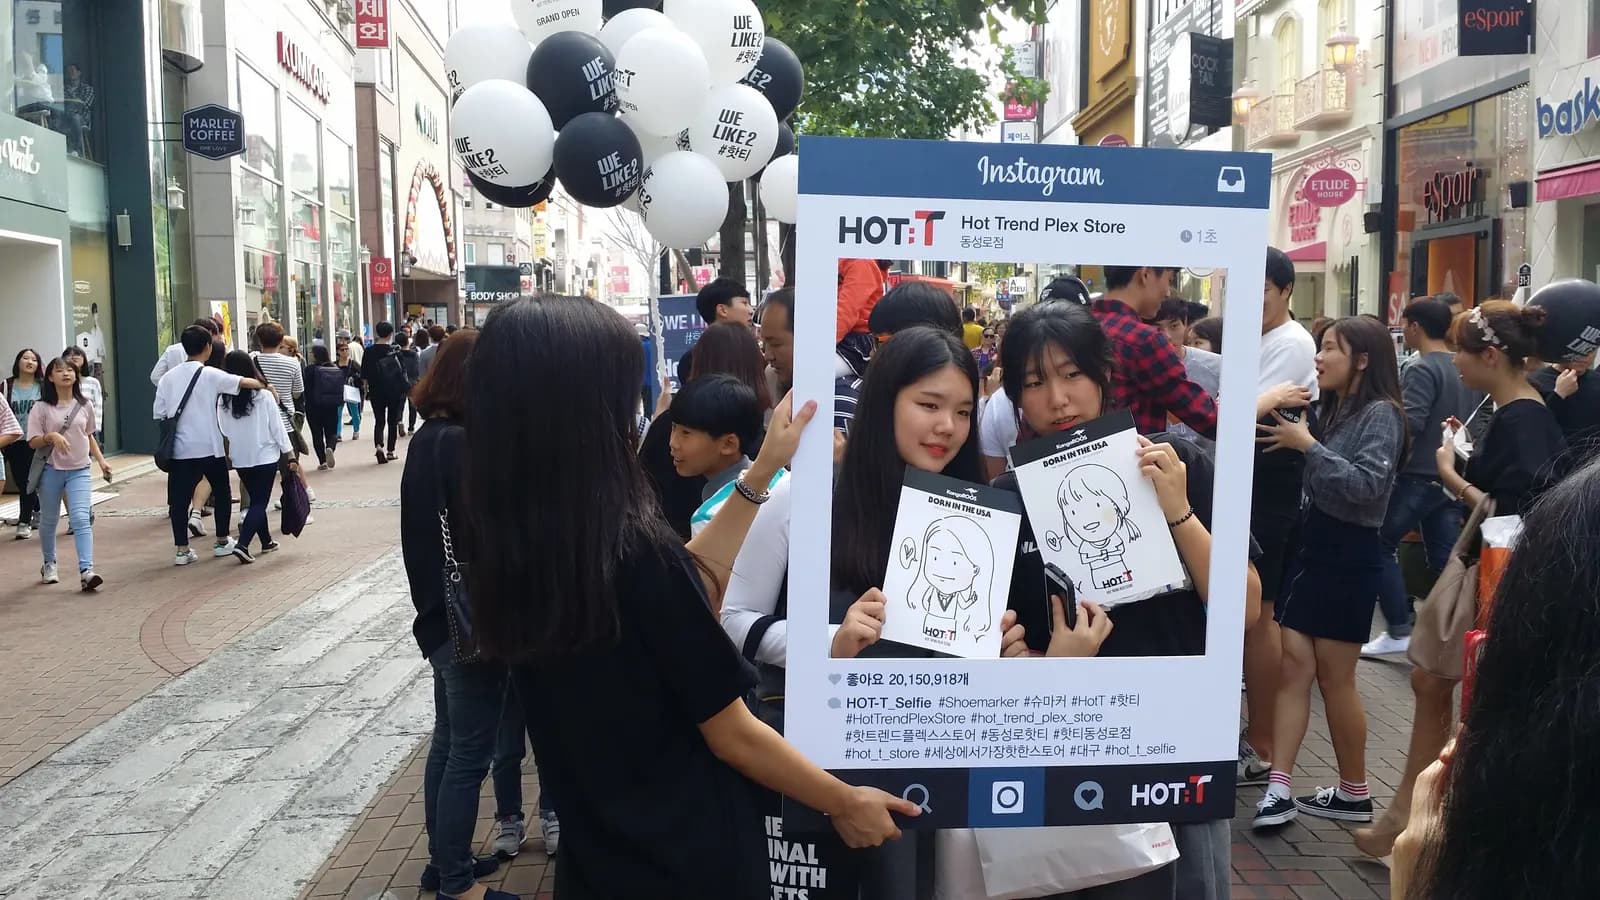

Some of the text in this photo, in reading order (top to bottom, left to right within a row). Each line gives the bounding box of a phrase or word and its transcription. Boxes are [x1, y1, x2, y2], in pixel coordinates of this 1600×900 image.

[536, 8, 581, 27] GRAND OPEN
[733, 15, 753, 30] WE
[582, 56, 607, 82] WE
[190, 118, 236, 129] MARLEY
[718, 108, 745, 126] WE
[190, 130, 235, 141] COFFEE
[455, 136, 473, 154] WE
[718, 144, 752, 162] #핫티
[597, 151, 622, 175] WE
[977, 155, 1106, 197] Instagram
[1311, 179, 1350, 191] ETUDE
[960, 215, 1126, 235] Hot Trend Plex Store
[960, 235, 1004, 249] 동성로점
[1197, 229, 1218, 243] 1초
[471, 292, 494, 300] BODY
[664, 314, 688, 330] WE
[1043, 454, 1067, 467] BORN
[1067, 450, 1077, 459] IN
[1076, 445, 1091, 455] THE
[1091, 440, 1108, 451] USA
[928, 496, 951, 508] BORN
[952, 502, 961, 510] IN
[962, 504, 975, 514] THE
[976, 508, 991, 518] USA
[846, 672, 969, 687] 좋아요 20,150,918개
[846, 693, 1140, 710] HOT-T_Selfie #Shoemarker #슈마커 #HotT #핫티
[845, 711, 1103, 725] #HotTrendPlexStore #hot_trend_plex_store
[845, 726, 1132, 743] #핫트렌드플렉스스토어 #동성로핫티 #핫티동성로점
[845, 743, 1177, 761] #hot_t_store #세상에서가장핫한스토어 #대구 #hot_t_selfie
[769, 861, 827, 889] WITH
